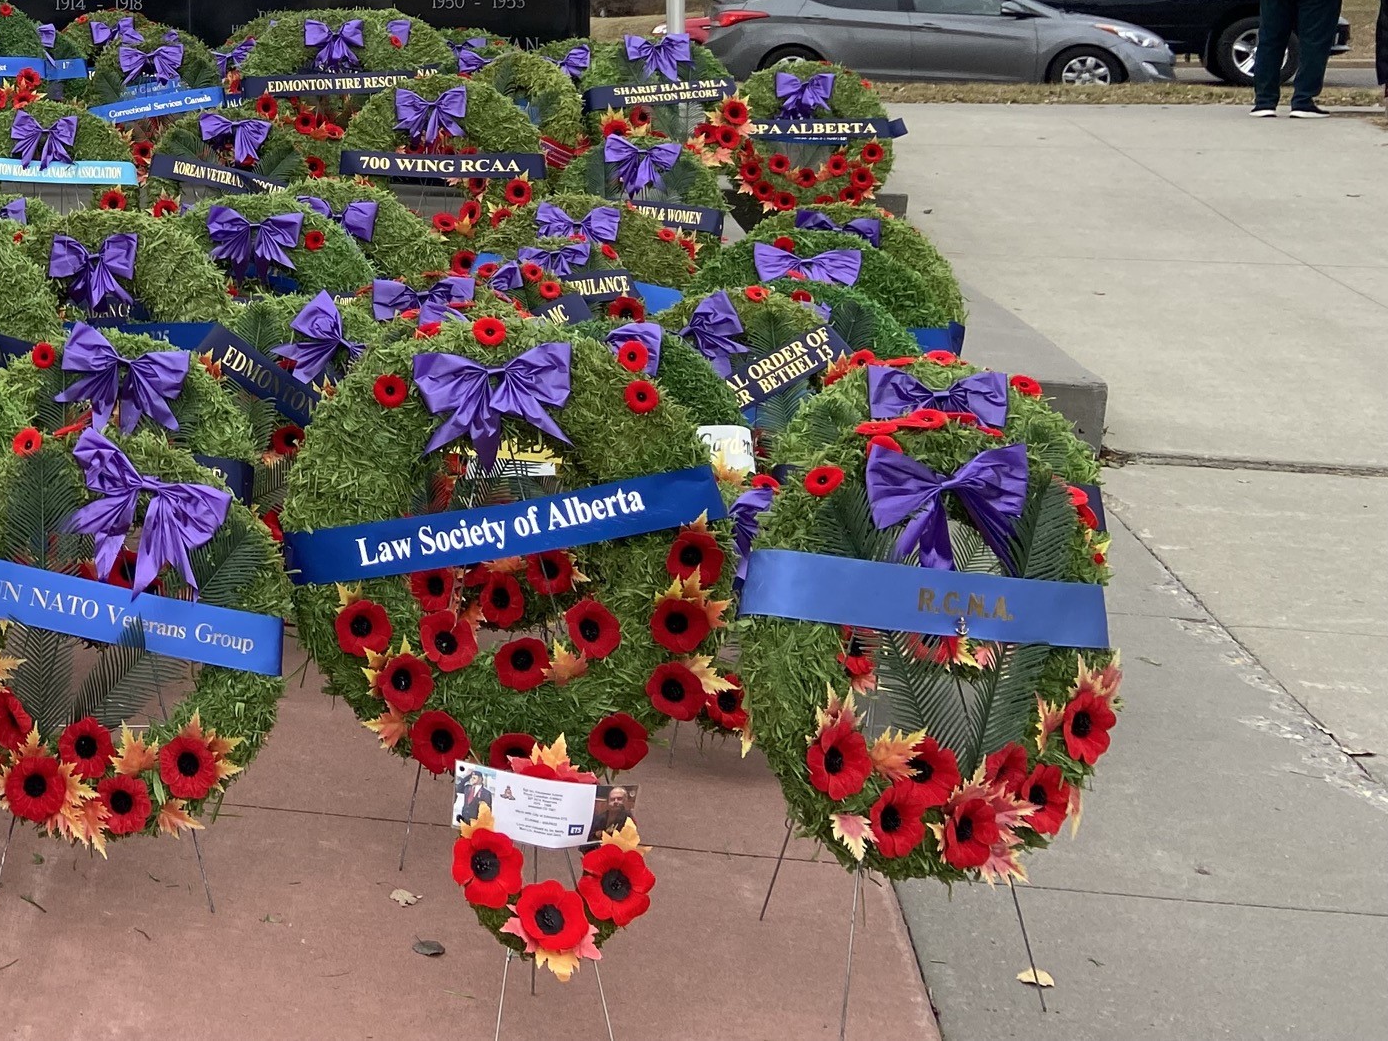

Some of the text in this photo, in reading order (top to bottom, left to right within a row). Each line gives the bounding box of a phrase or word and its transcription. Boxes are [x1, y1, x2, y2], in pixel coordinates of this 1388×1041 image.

[267, 77, 335, 93] EDMONTON
[335, 77, 362, 90] FIRE
[613, 84, 658, 96] SHARIF
[661, 82, 690, 92] HAJI
[698, 79, 728, 89] MLA
[624, 88, 719, 105] EDMONTON DECORE
[108, 102, 152, 119] Correctional
[153, 99, 183, 111] Services
[183, 94, 212, 106] Canada
[786, 123, 877, 135] ALBERTA
[12, 164, 41, 177] KOREAN
[77, 165, 122, 179] ASSOCIATION
[173, 160, 206, 178] KOREAN
[359, 156, 521, 173] 700 WING RCAA
[657, 207, 666, 221] &
[667, 208, 702, 225] WOMEN
[747, 340, 809, 380] ORDER
[805, 326, 830, 348] OF
[757, 354, 819, 394] BETHEL
[815, 344, 834, 362] 13
[355, 487, 646, 567] Law Society of Alberta
[29, 587, 100, 620] NATO
[106, 604, 187, 640] Veterans
[194, 623, 255, 654] Group
